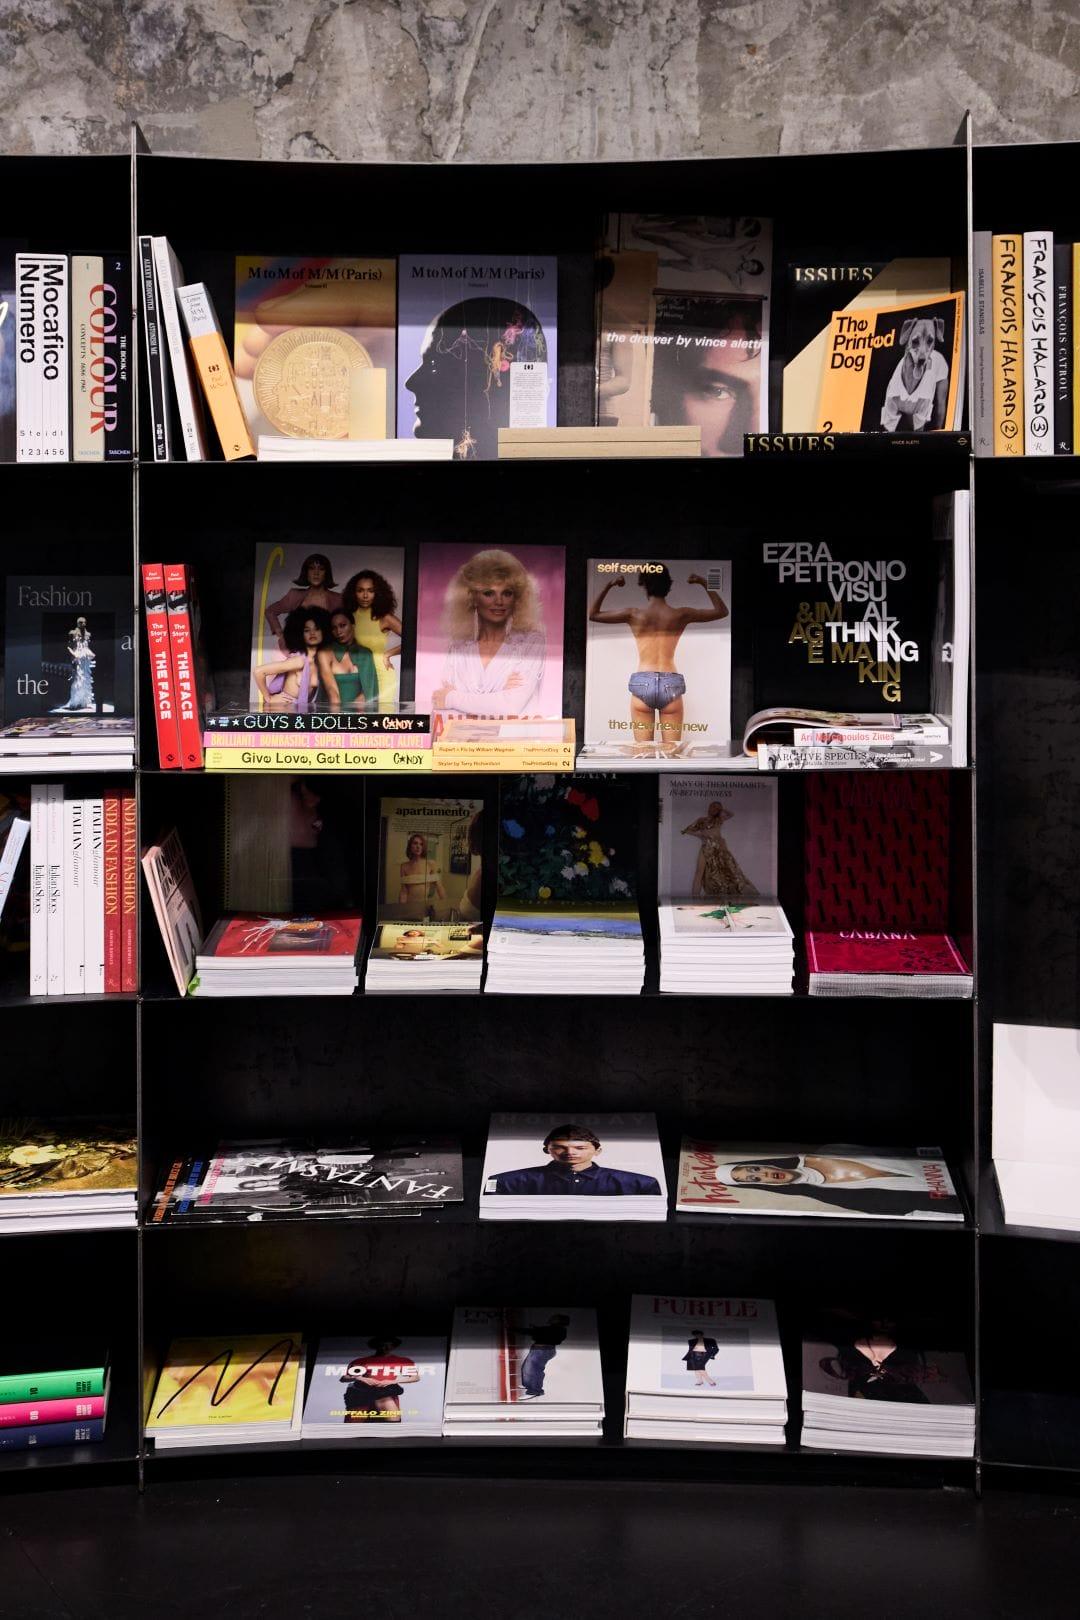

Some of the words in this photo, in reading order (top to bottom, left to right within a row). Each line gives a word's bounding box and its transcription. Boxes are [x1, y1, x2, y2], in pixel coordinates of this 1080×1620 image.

[115, 261, 121, 270] 2
[248, 267, 262, 279] M
[263, 268, 276, 279] to
[276, 268, 293, 279] M
[294, 267, 306, 280] of
[308, 268, 339, 280] M/M
[341, 268, 383, 281] (Paris)
[411, 266, 426, 279] M
[427, 268, 439, 279] to
[440, 267, 454, 279] M
[455, 266, 467, 279] of
[470, 267, 501, 279] M/M
[504, 267, 545, 280] (Paris)
[795, 267, 873, 281] ISSUES
[20, 264, 39, 363] Numero
[43, 264, 64, 380] Mocafico
[836, 317, 868, 333] The
[606, 332, 626, 343] the
[629, 333, 674, 346] drawer
[676, 334, 691, 348] by
[695, 336, 727, 349] vince
[833, 329, 895, 351] Printed
[89, 283, 118, 435] COLOUR
[831, 352, 865, 372] Dog
[1000, 340, 1018, 417] HALARD
[1031, 338, 1048, 415] HALARD
[747, 436, 835, 451] ISSUES
[763, 542, 833, 563] EZRA
[597, 562, 619, 573] self
[620, 563, 664, 574] service
[779, 560, 907, 583] PETRONIO
[18, 585, 92, 607] Fashion
[828, 581, 887, 602] VISU
[863, 601, 897, 622] AL
[150, 630, 168, 638] Story
[172, 630, 189, 638] Story
[788, 622, 824, 644] AG
[825, 621, 902, 643] THINK
[808, 640, 824, 663] E
[831, 642, 874, 663] MA
[877, 641, 919, 662] ING
[155, 651, 169, 679] THE
[177, 651, 190, 679] THE
[858, 661, 901, 683] KIN
[16, 674, 49, 695] the
[882, 681, 901, 702] G
[157, 682, 172, 720] FACE
[180, 682, 194, 720] FACE
[243, 716, 289, 729] GUYS
[294, 716, 306, 729] &
[311, 716, 368, 729] DOLLS
[608, 719, 628, 730] the
[683, 722, 708, 732] new
[314, 736, 345, 747] SUPER!
[350, 736, 394, 747] FANTASTIC!
[397, 736, 424, 747] ALIVE!
[872, 732, 895, 742] Zines
[241, 752, 272, 764] Give
[275, 752, 312, 766] Love,
[316, 752, 340, 764] Get
[345, 752, 377, 764] Love
[776, 752, 822, 762] ARCHIVE
[824, 751, 867, 761] SPECIES
[105, 798, 118, 837] INDIA
[124, 798, 136, 837] INDIA
[395, 806, 471, 818] apartamento
[72, 805, 82, 850] ITALIAN
[92, 805, 102, 849] ITALIAN
[105, 838, 118, 853] IN
[124, 838, 136, 853] IN
[105, 856, 118, 915] FASHION
[124, 855, 136, 914] FASHION
[839, 929, 918, 940] CABANA
[653, 1297, 758, 1317] PURPLE
[325, 1365, 436, 1377] MOTHER
